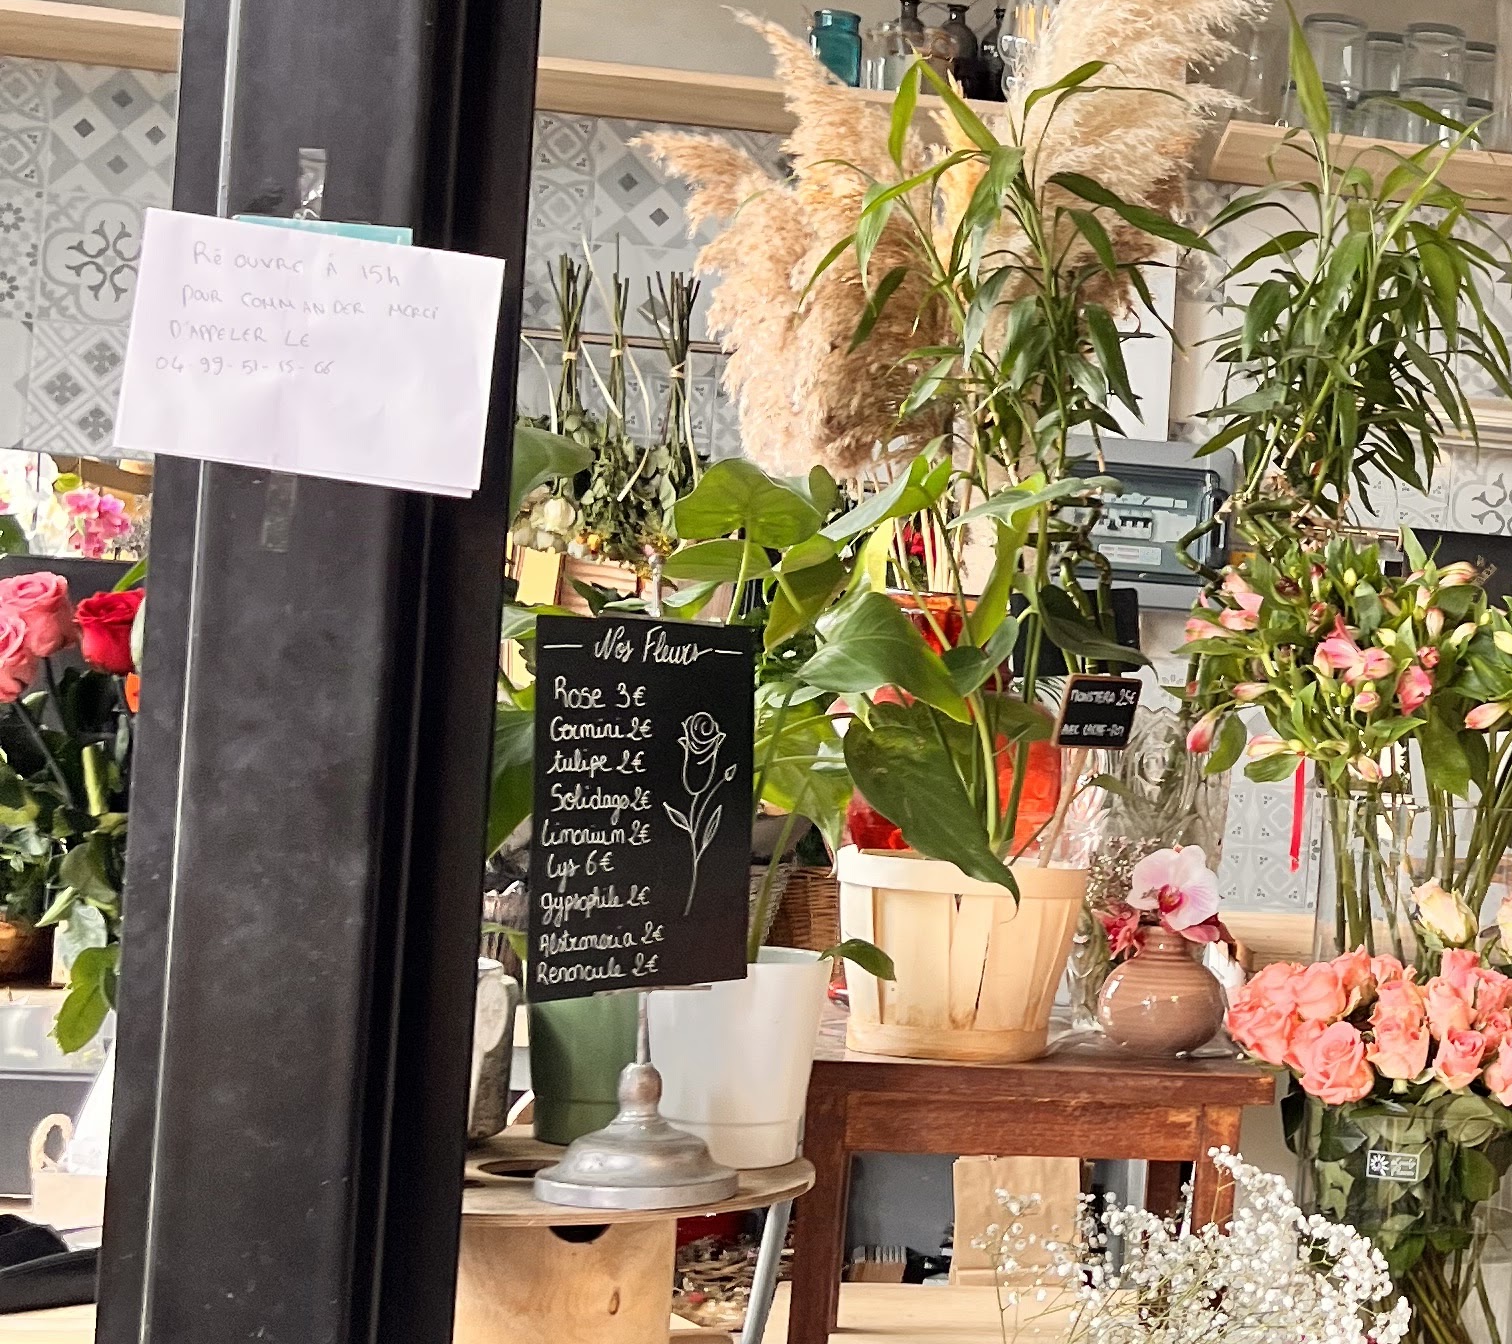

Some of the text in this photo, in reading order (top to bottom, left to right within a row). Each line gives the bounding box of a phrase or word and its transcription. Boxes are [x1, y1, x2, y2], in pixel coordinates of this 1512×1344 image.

[284, 330, 311, 348] LE
[594, 625, 713, 666] Nos Fleurs
[553, 675, 647, 709] Rose 3€
[626, 716, 653, 741] 2€
[546, 747, 648, 779] tulipe 2€
[550, 782, 653, 826] Solidago 2€
[628, 819, 652, 846] 2€
[585, 849, 615, 876] 6€
[626, 884, 651, 907] 2€
[640, 920, 666, 945] 2€
[631, 952, 659, 977] 2€
